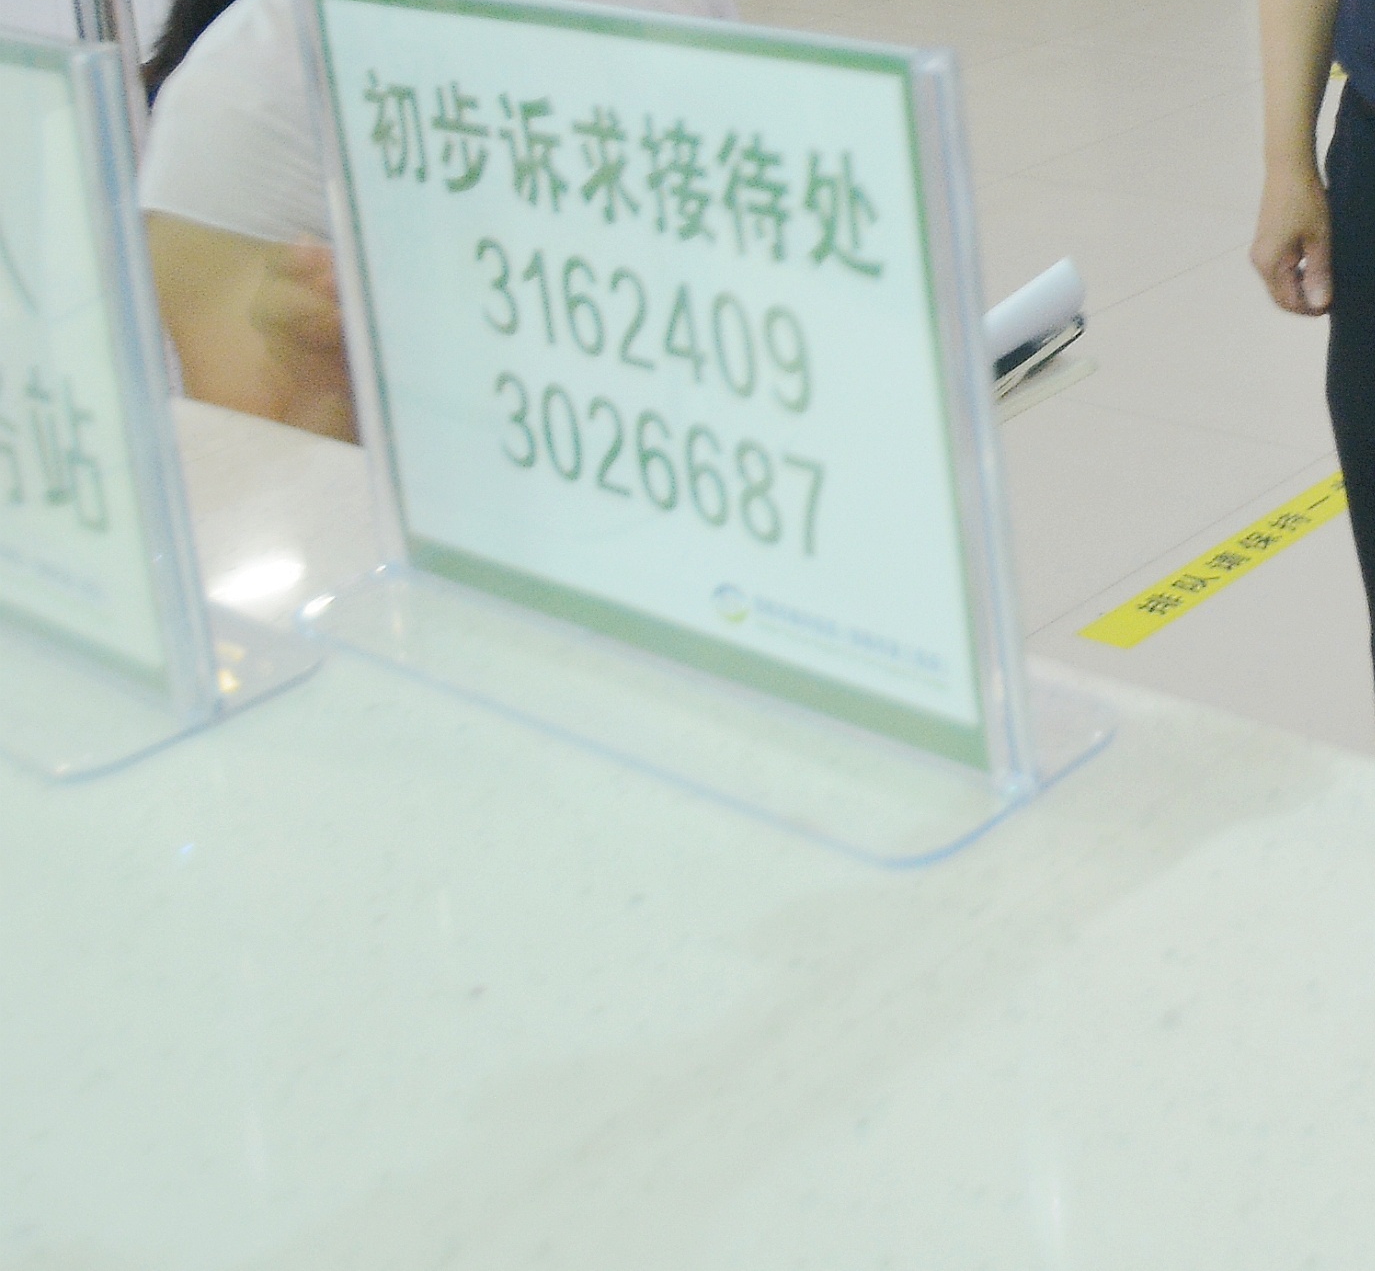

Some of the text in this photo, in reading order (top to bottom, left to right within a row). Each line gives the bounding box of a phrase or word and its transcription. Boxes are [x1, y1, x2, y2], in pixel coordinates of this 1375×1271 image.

[362, 70, 887, 280] 初步诉求接待处
[471, 235, 813, 415] 3162409
[493, 371, 829, 558] 3026687
